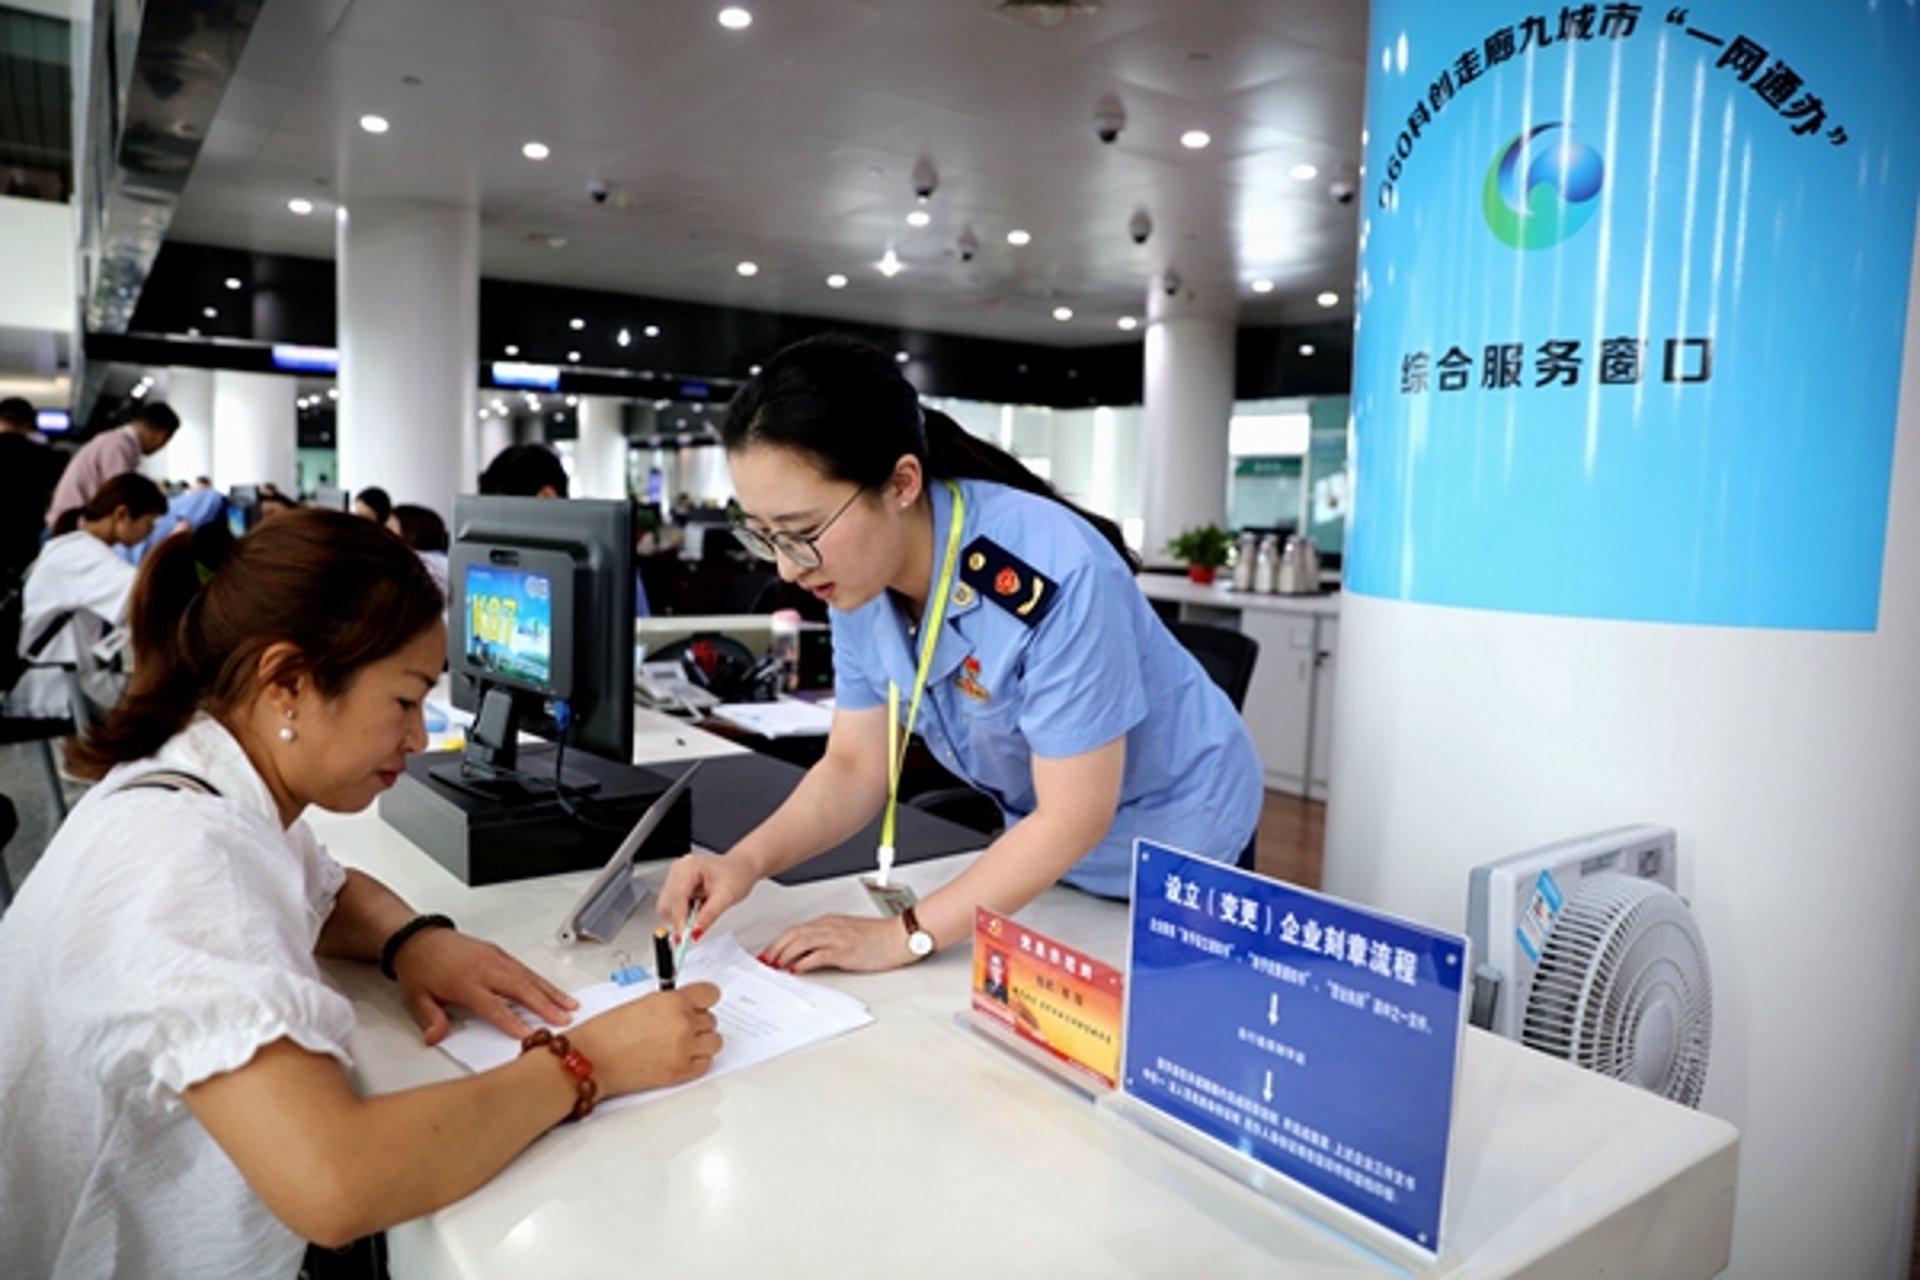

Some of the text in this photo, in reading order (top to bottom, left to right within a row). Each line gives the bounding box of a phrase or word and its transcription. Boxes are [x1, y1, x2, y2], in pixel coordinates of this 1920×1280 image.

[1401, 336, 1714, 394] 综合服务窗口
